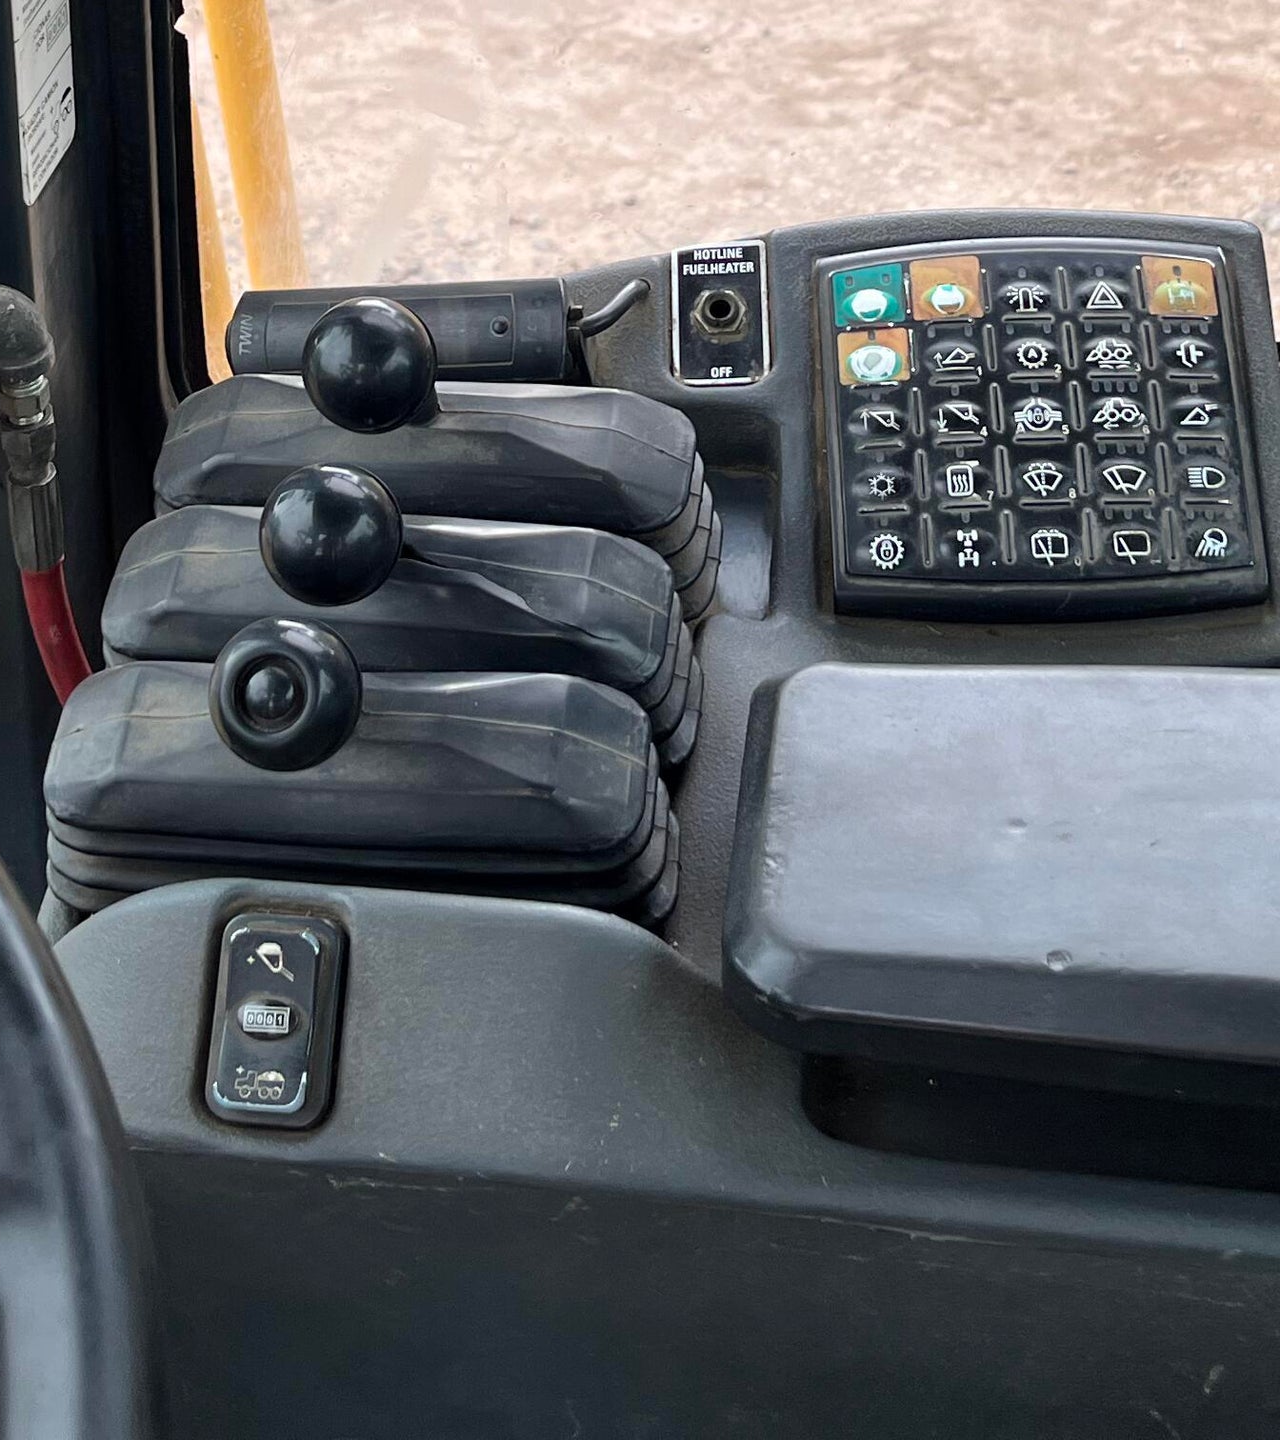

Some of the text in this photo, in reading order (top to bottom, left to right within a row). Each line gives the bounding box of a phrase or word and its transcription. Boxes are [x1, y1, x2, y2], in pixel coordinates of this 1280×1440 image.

[693, 247, 743, 261] HOTLINE
[682, 261, 755, 276] FUELHEATER
[710, 366, 733, 378] OFF
[979, 426, 988, 437] 4
[1061, 424, 1070, 435] 5
